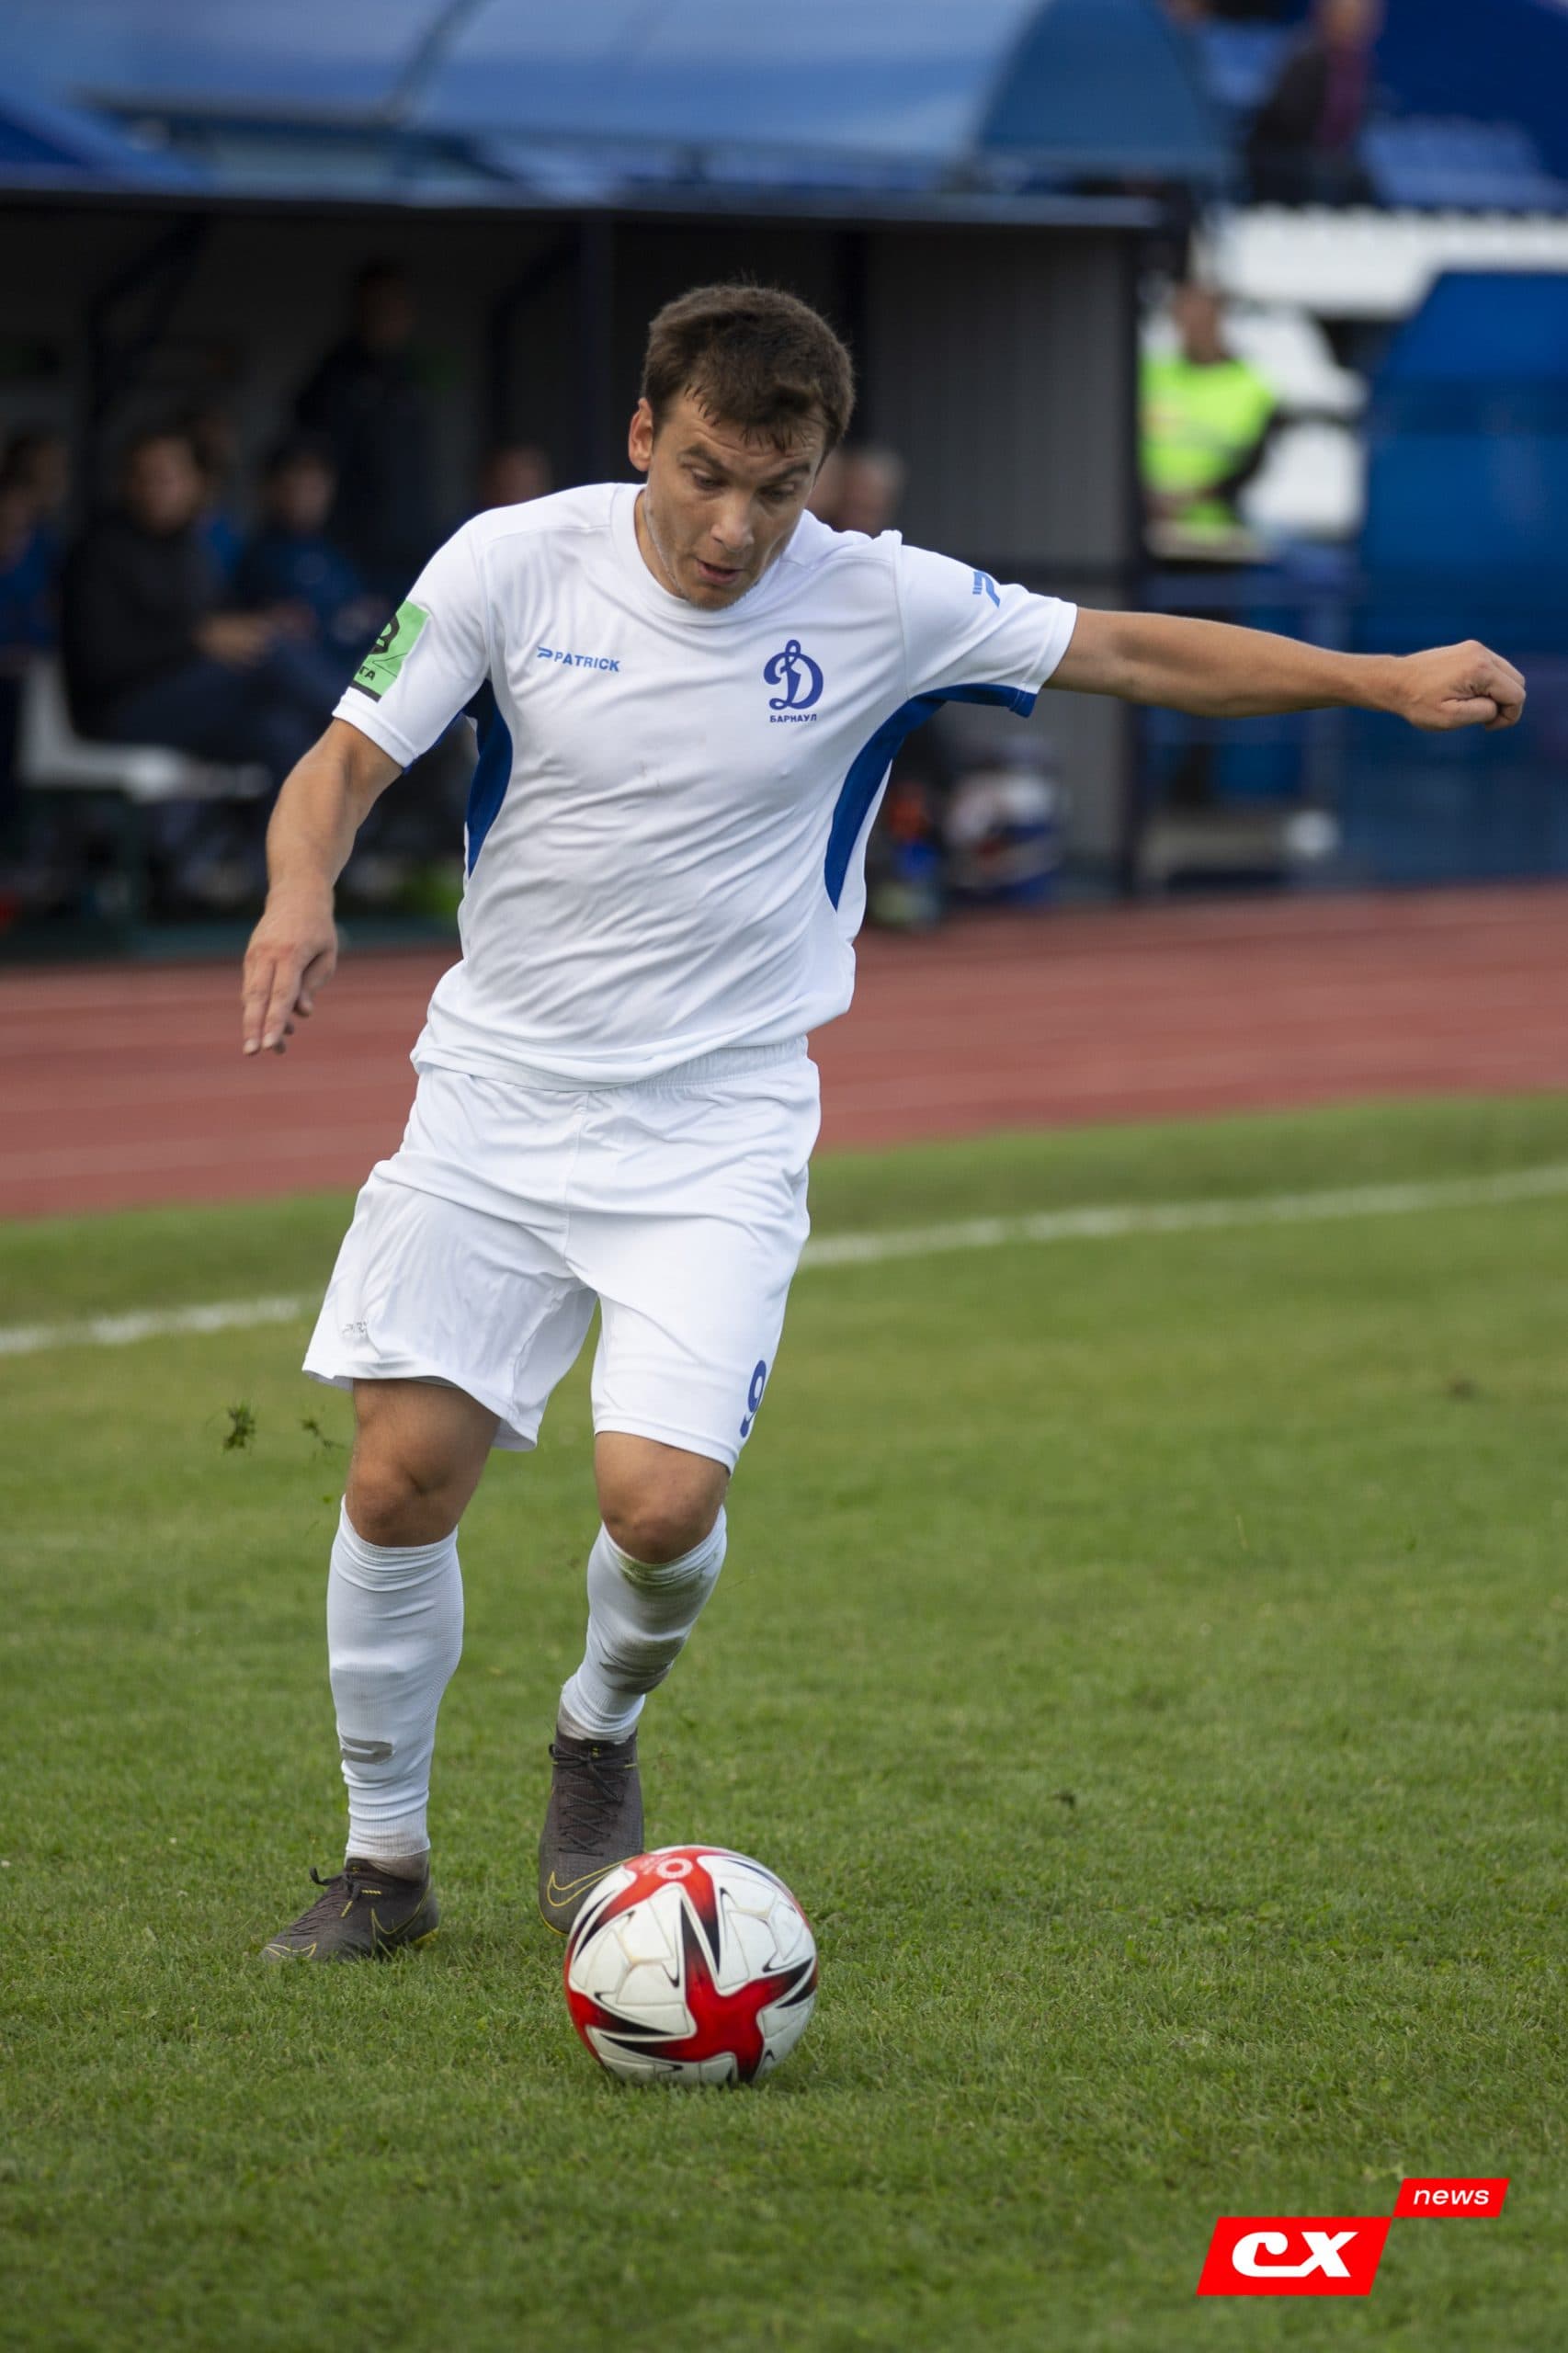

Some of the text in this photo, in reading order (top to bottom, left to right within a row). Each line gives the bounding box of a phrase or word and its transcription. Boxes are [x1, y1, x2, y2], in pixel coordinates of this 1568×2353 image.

[554, 651, 620, 672] PATRICK
[769, 713, 817, 722] БАРНАУЛ
[739, 1359, 767, 1438] 9
